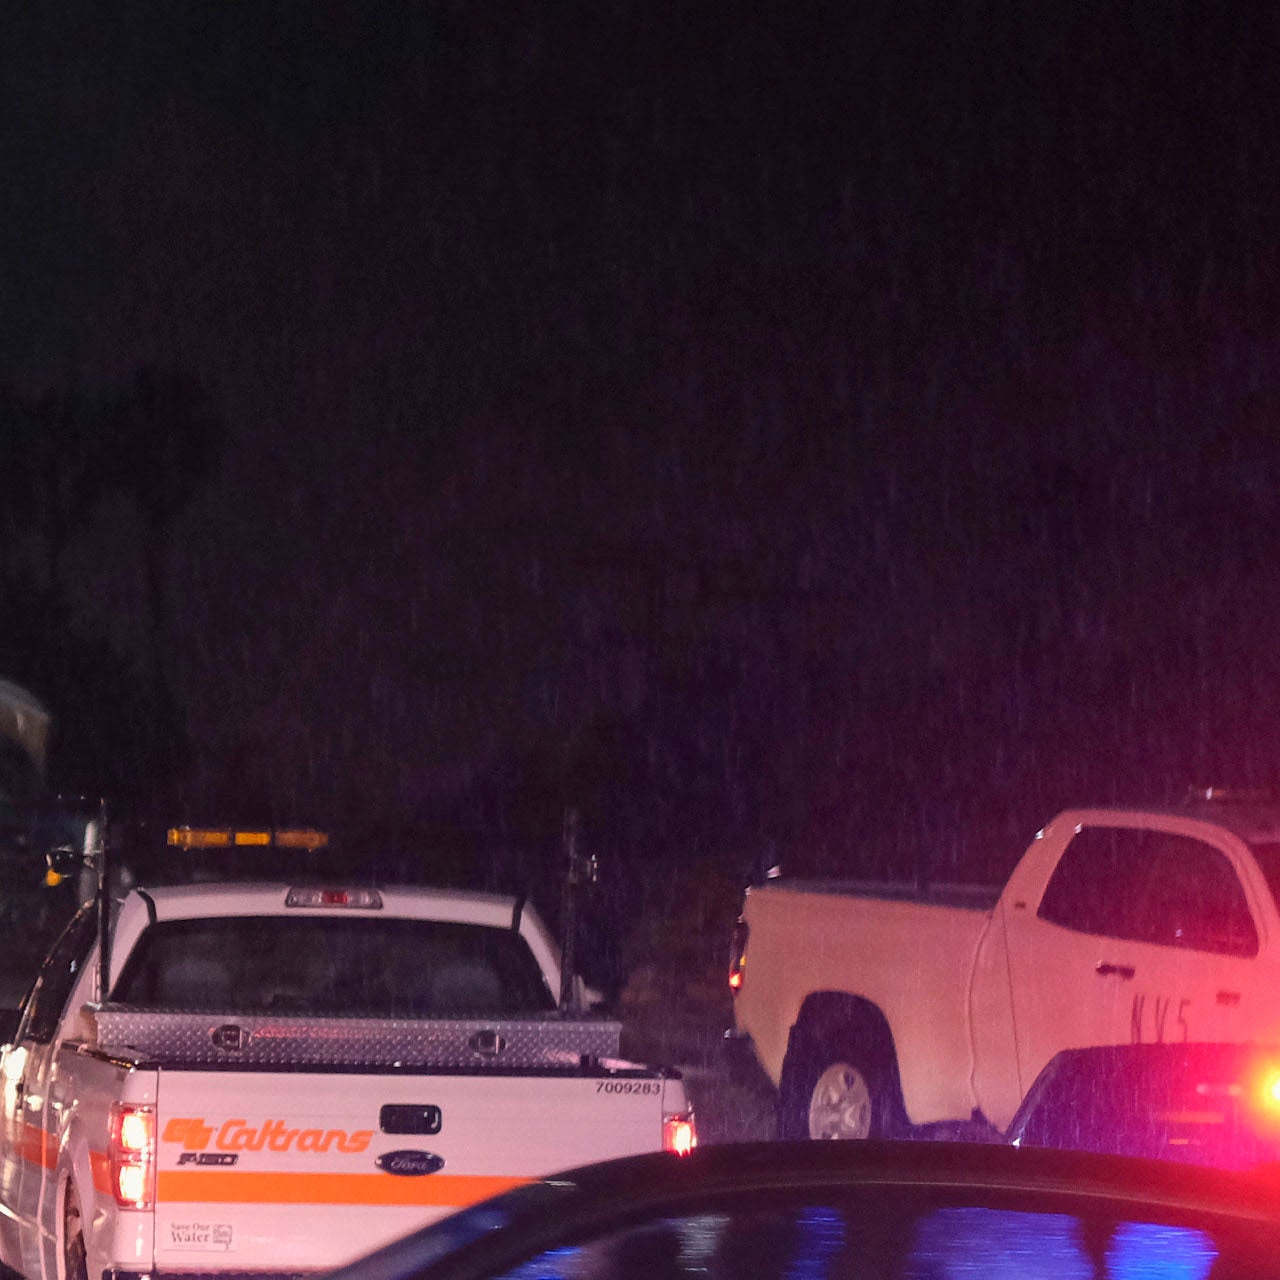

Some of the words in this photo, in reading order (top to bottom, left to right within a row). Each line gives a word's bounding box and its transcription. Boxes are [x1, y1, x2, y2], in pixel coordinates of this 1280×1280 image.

[595, 1081, 661, 1096] 7009283
[215, 1119, 376, 1154] Caltrans
[170, 1231, 211, 1243] Water
